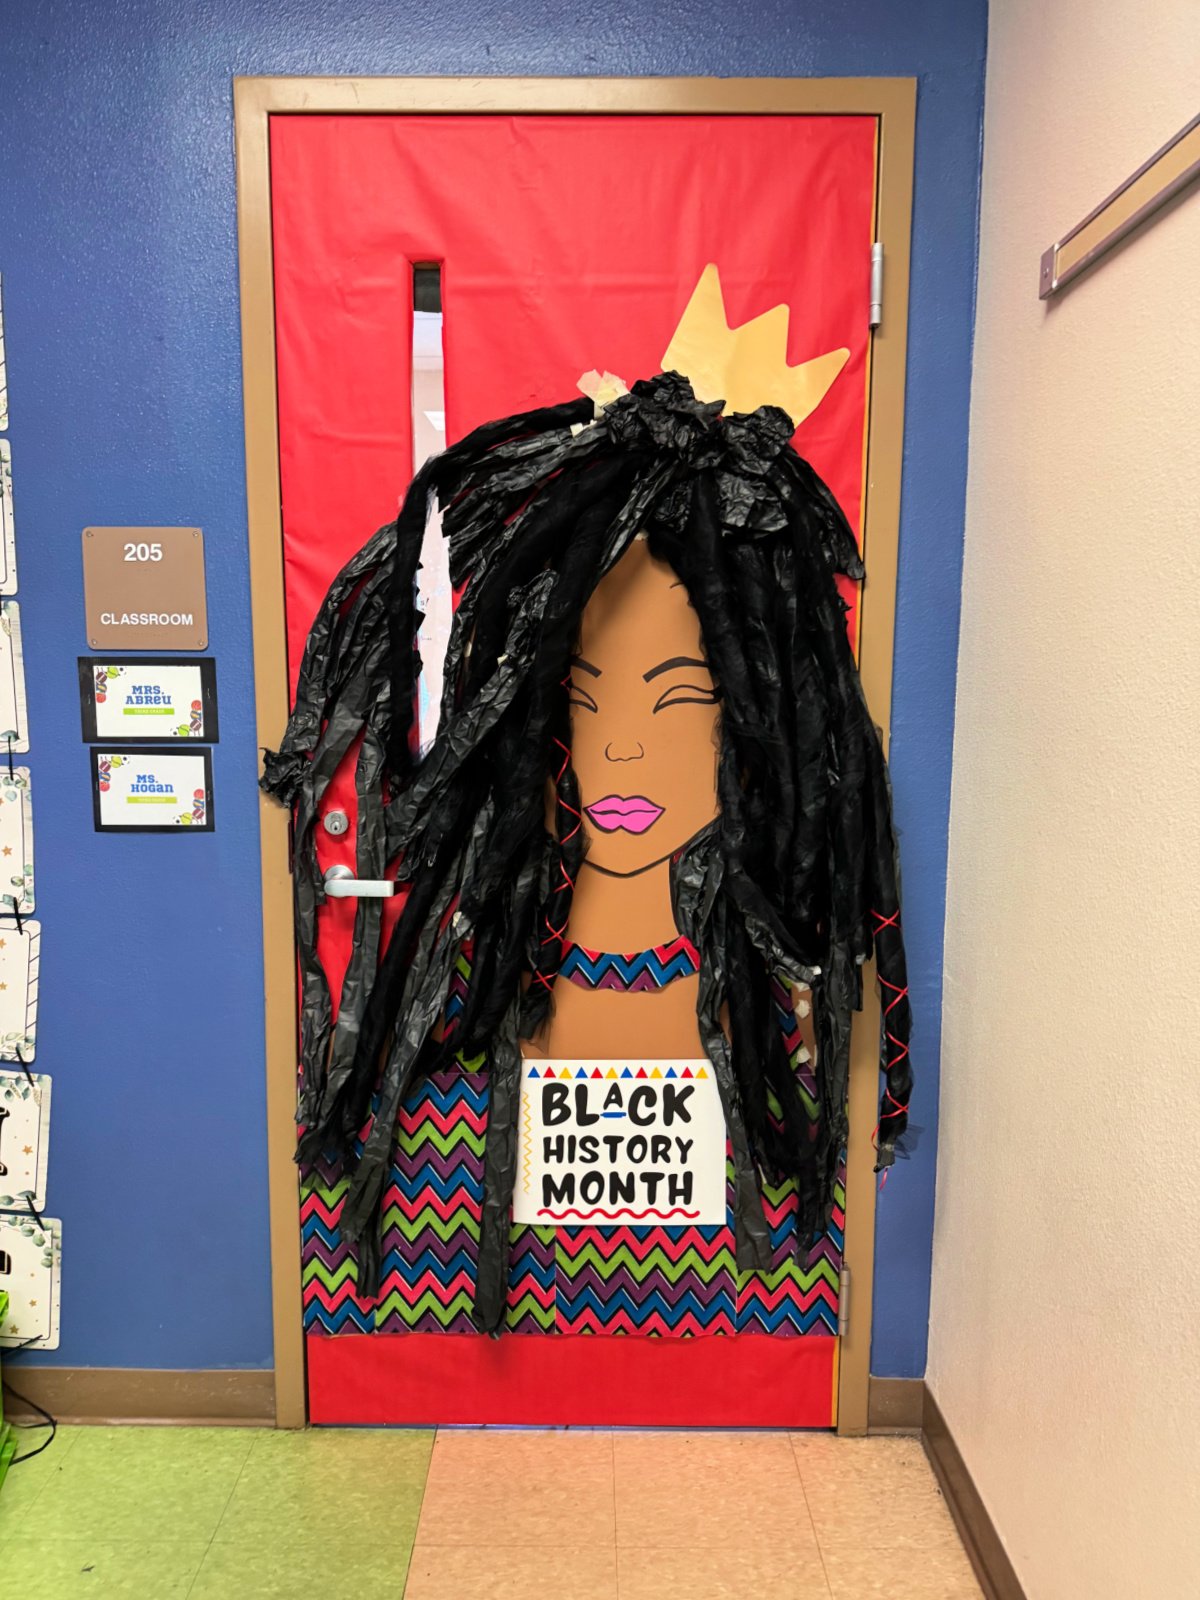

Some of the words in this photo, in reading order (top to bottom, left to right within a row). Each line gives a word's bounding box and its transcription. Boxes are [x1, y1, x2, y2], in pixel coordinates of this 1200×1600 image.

[124, 543, 163, 562] 205
[100, 613, 194, 626] CLASSROOM
[131, 685, 164, 695] MRS.
[136, 774, 159, 784] MS.
[542, 1082, 695, 1127] BLACK
[543, 1134, 694, 1165] HISTORY
[542, 1170, 694, 1208] MONTH
